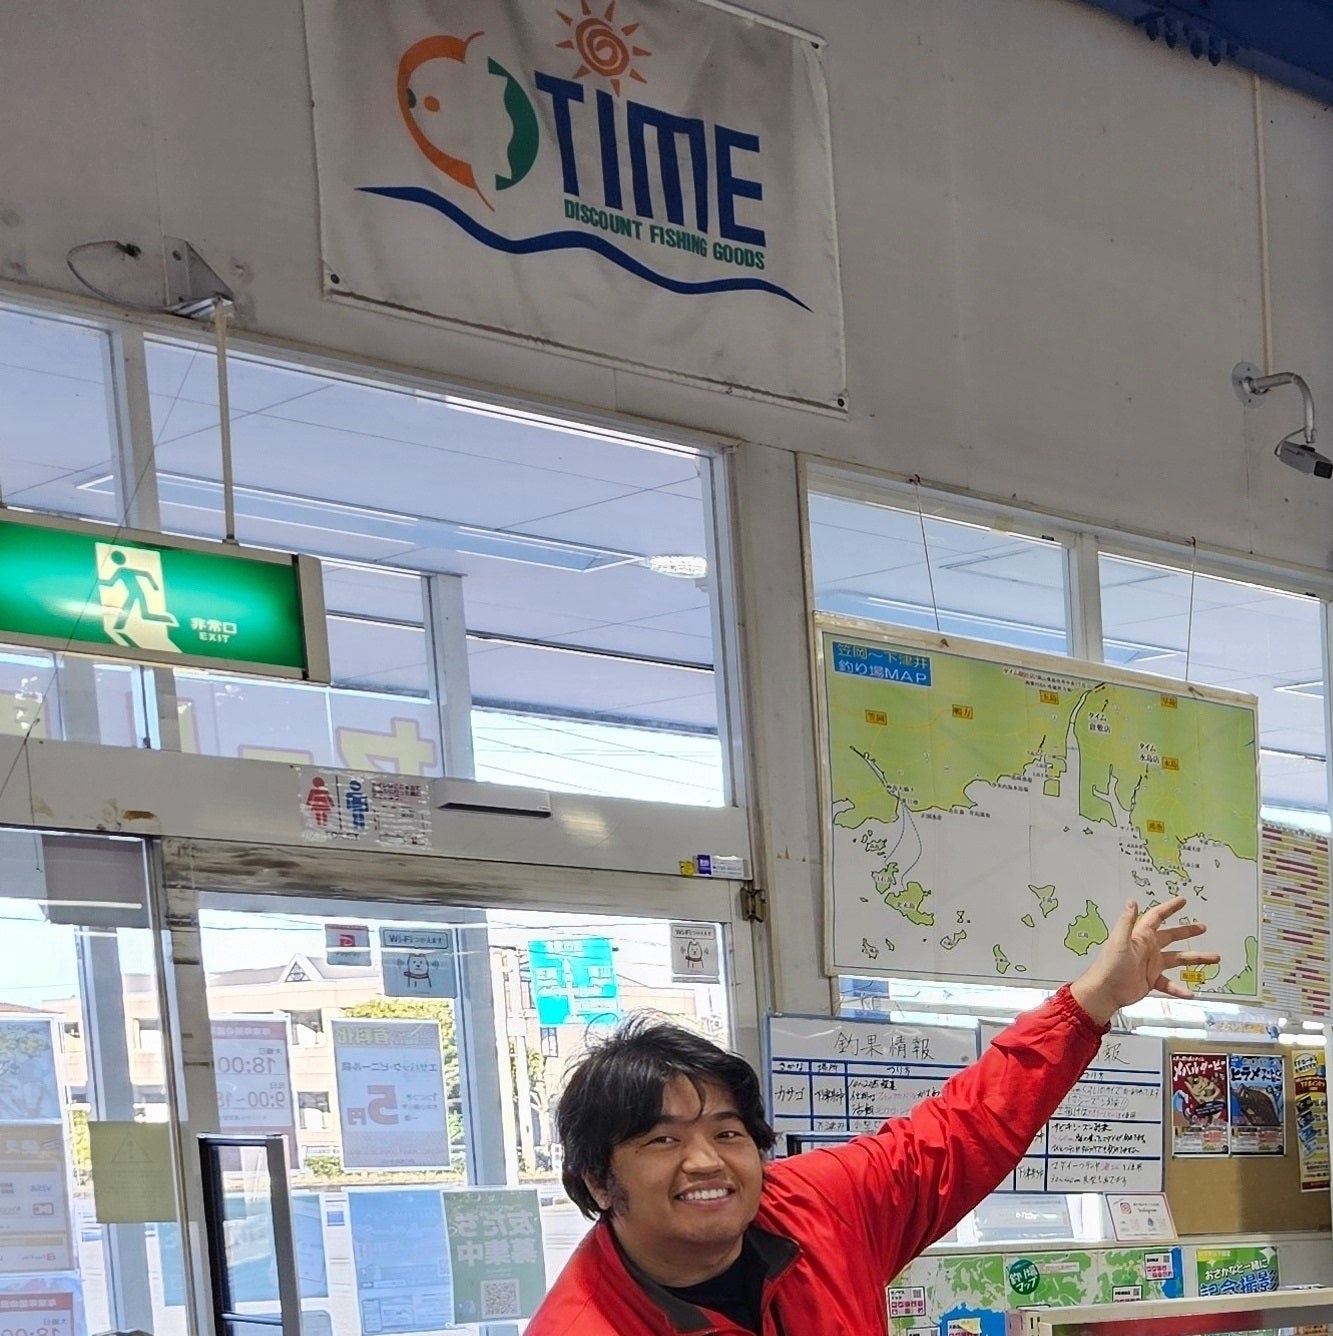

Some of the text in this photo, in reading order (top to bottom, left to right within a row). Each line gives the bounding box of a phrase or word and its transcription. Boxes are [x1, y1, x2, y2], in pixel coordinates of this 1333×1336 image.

[534, 70, 767, 247] TIME
[564, 199, 766, 270] DISCOUNT FISHING GOODS
[190, 616, 237, 635] 非常口
[199, 632, 231, 644] EXIT
[838, 659, 927, 683] 釣り場MAP
[387, 931, 445, 947] Wi-Fiつかえます
[833, 1031, 936, 1061] 釣果情報
[778, 1062, 804, 1072] さかな
[1231, 1067, 1261, 1082] ヒラメ
[774, 1084, 806, 1102] カサゴ
[1204, 1259, 1269, 1279] おさかなと一緒に
[1015, 1279, 1036, 1292] マップ
